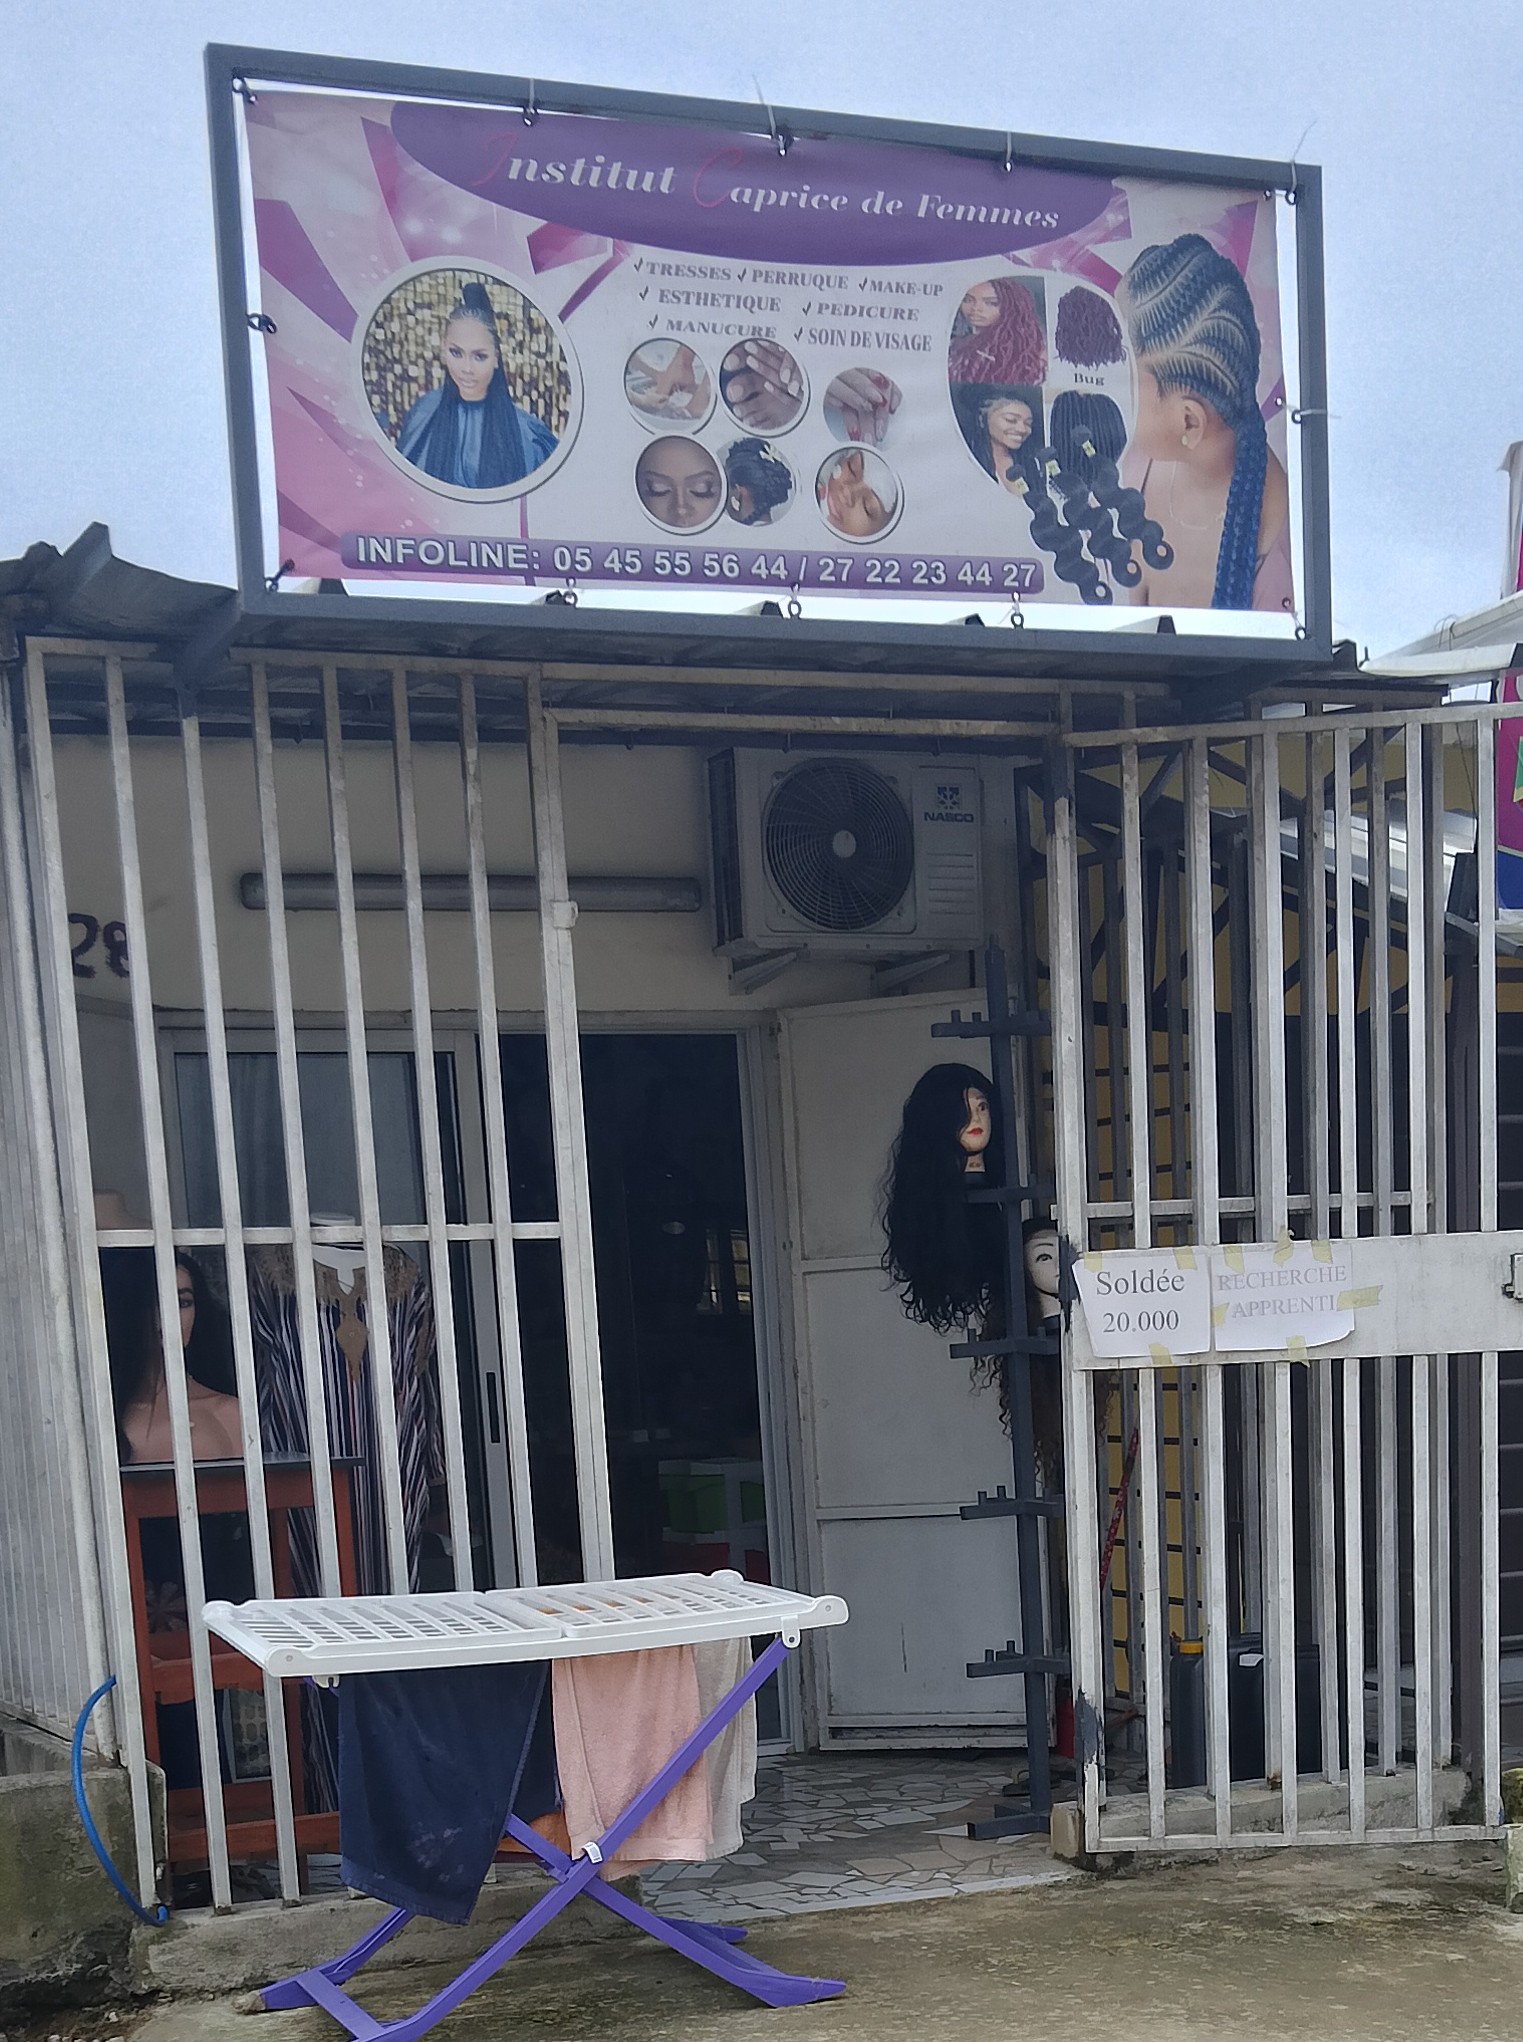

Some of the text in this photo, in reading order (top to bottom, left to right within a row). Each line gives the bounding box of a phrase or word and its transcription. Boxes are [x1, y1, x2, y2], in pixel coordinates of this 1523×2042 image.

[692, 147, 848, 213] Caprice
[861, 190, 904, 215] de
[917, 193, 1060, 229] Femmes
[646, 261, 944, 297] TRESSES PERRUQUE MAKE-UP
[658, 288, 920, 322] ESTHETIQUE PEDICURE
[665, 318, 933, 352] MANUCURE SOIN DE VISAGE
[356, 536, 1037, 588] INFOLINE: 05 45 55 56 44 / 27 22 23 44 27
[924, 811, 974, 823] NASCO
[1096, 1268, 1185, 1295] Soldée
[1217, 1265, 1347, 1292] RECHERCHE
[1103, 1309, 1180, 1334] 20.000
[1231, 1295, 1336, 1319] APPRENTI
